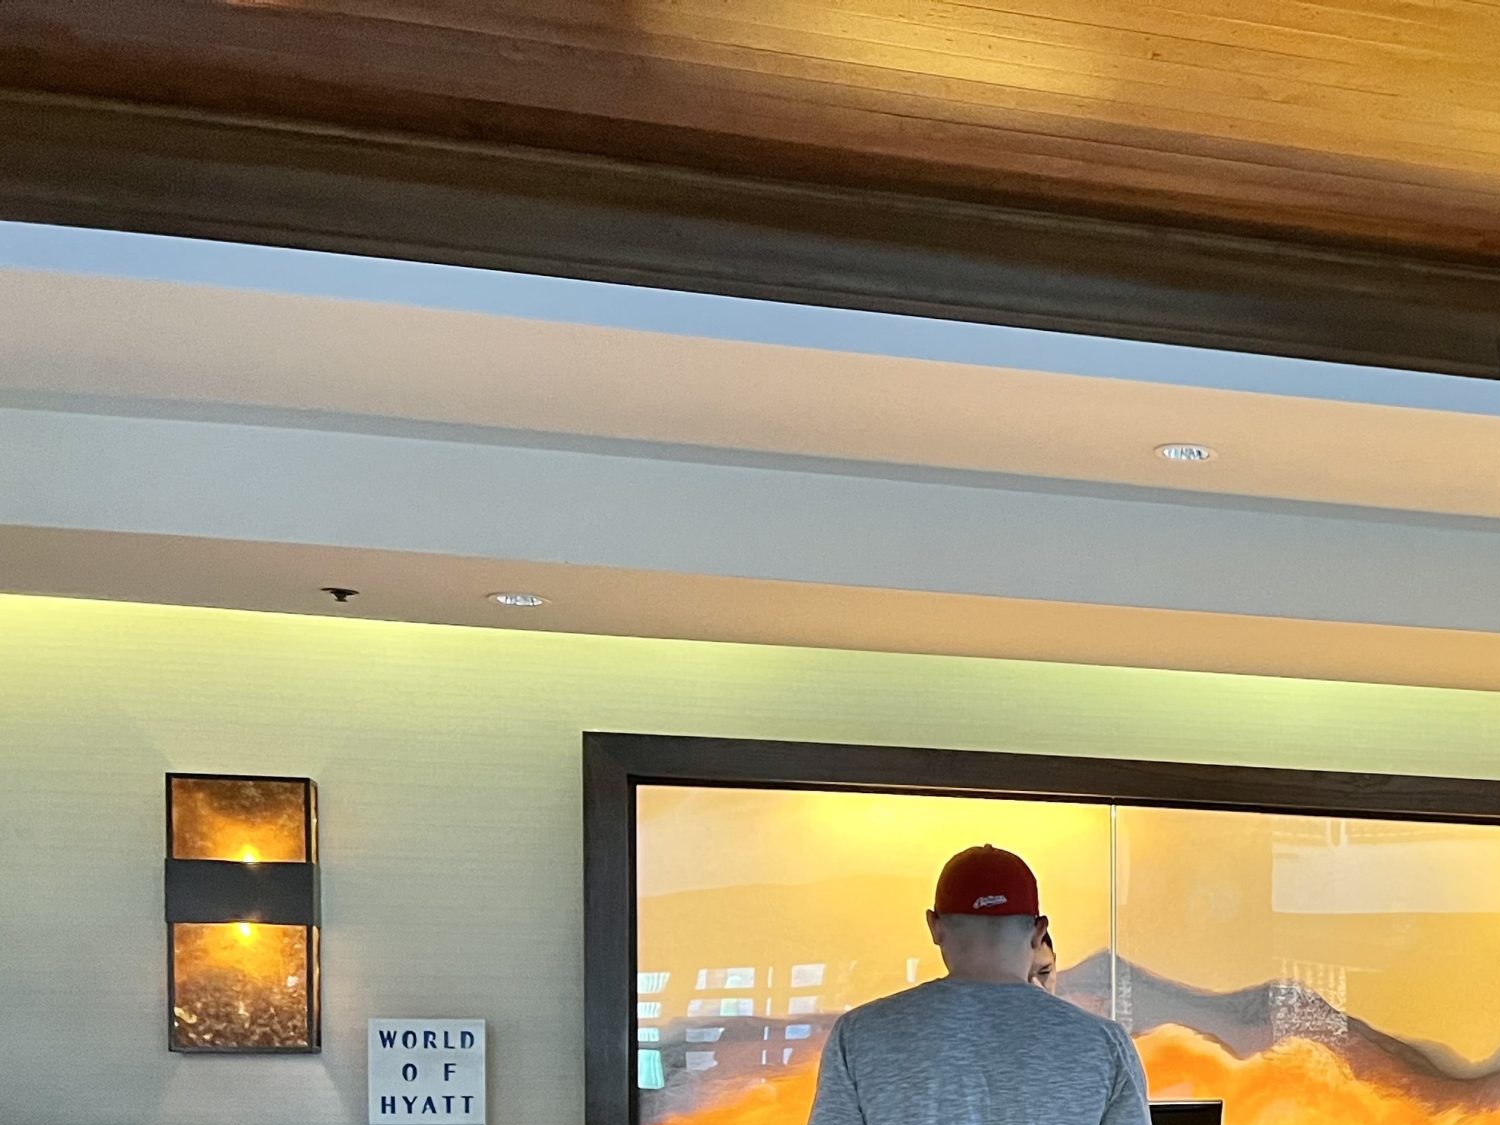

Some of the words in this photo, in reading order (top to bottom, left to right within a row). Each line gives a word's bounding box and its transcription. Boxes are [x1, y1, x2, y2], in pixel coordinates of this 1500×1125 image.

[379, 1030, 474, 1049] WORLD
[402, 1063, 456, 1081] OF
[381, 1096, 474, 1114] HYATT
